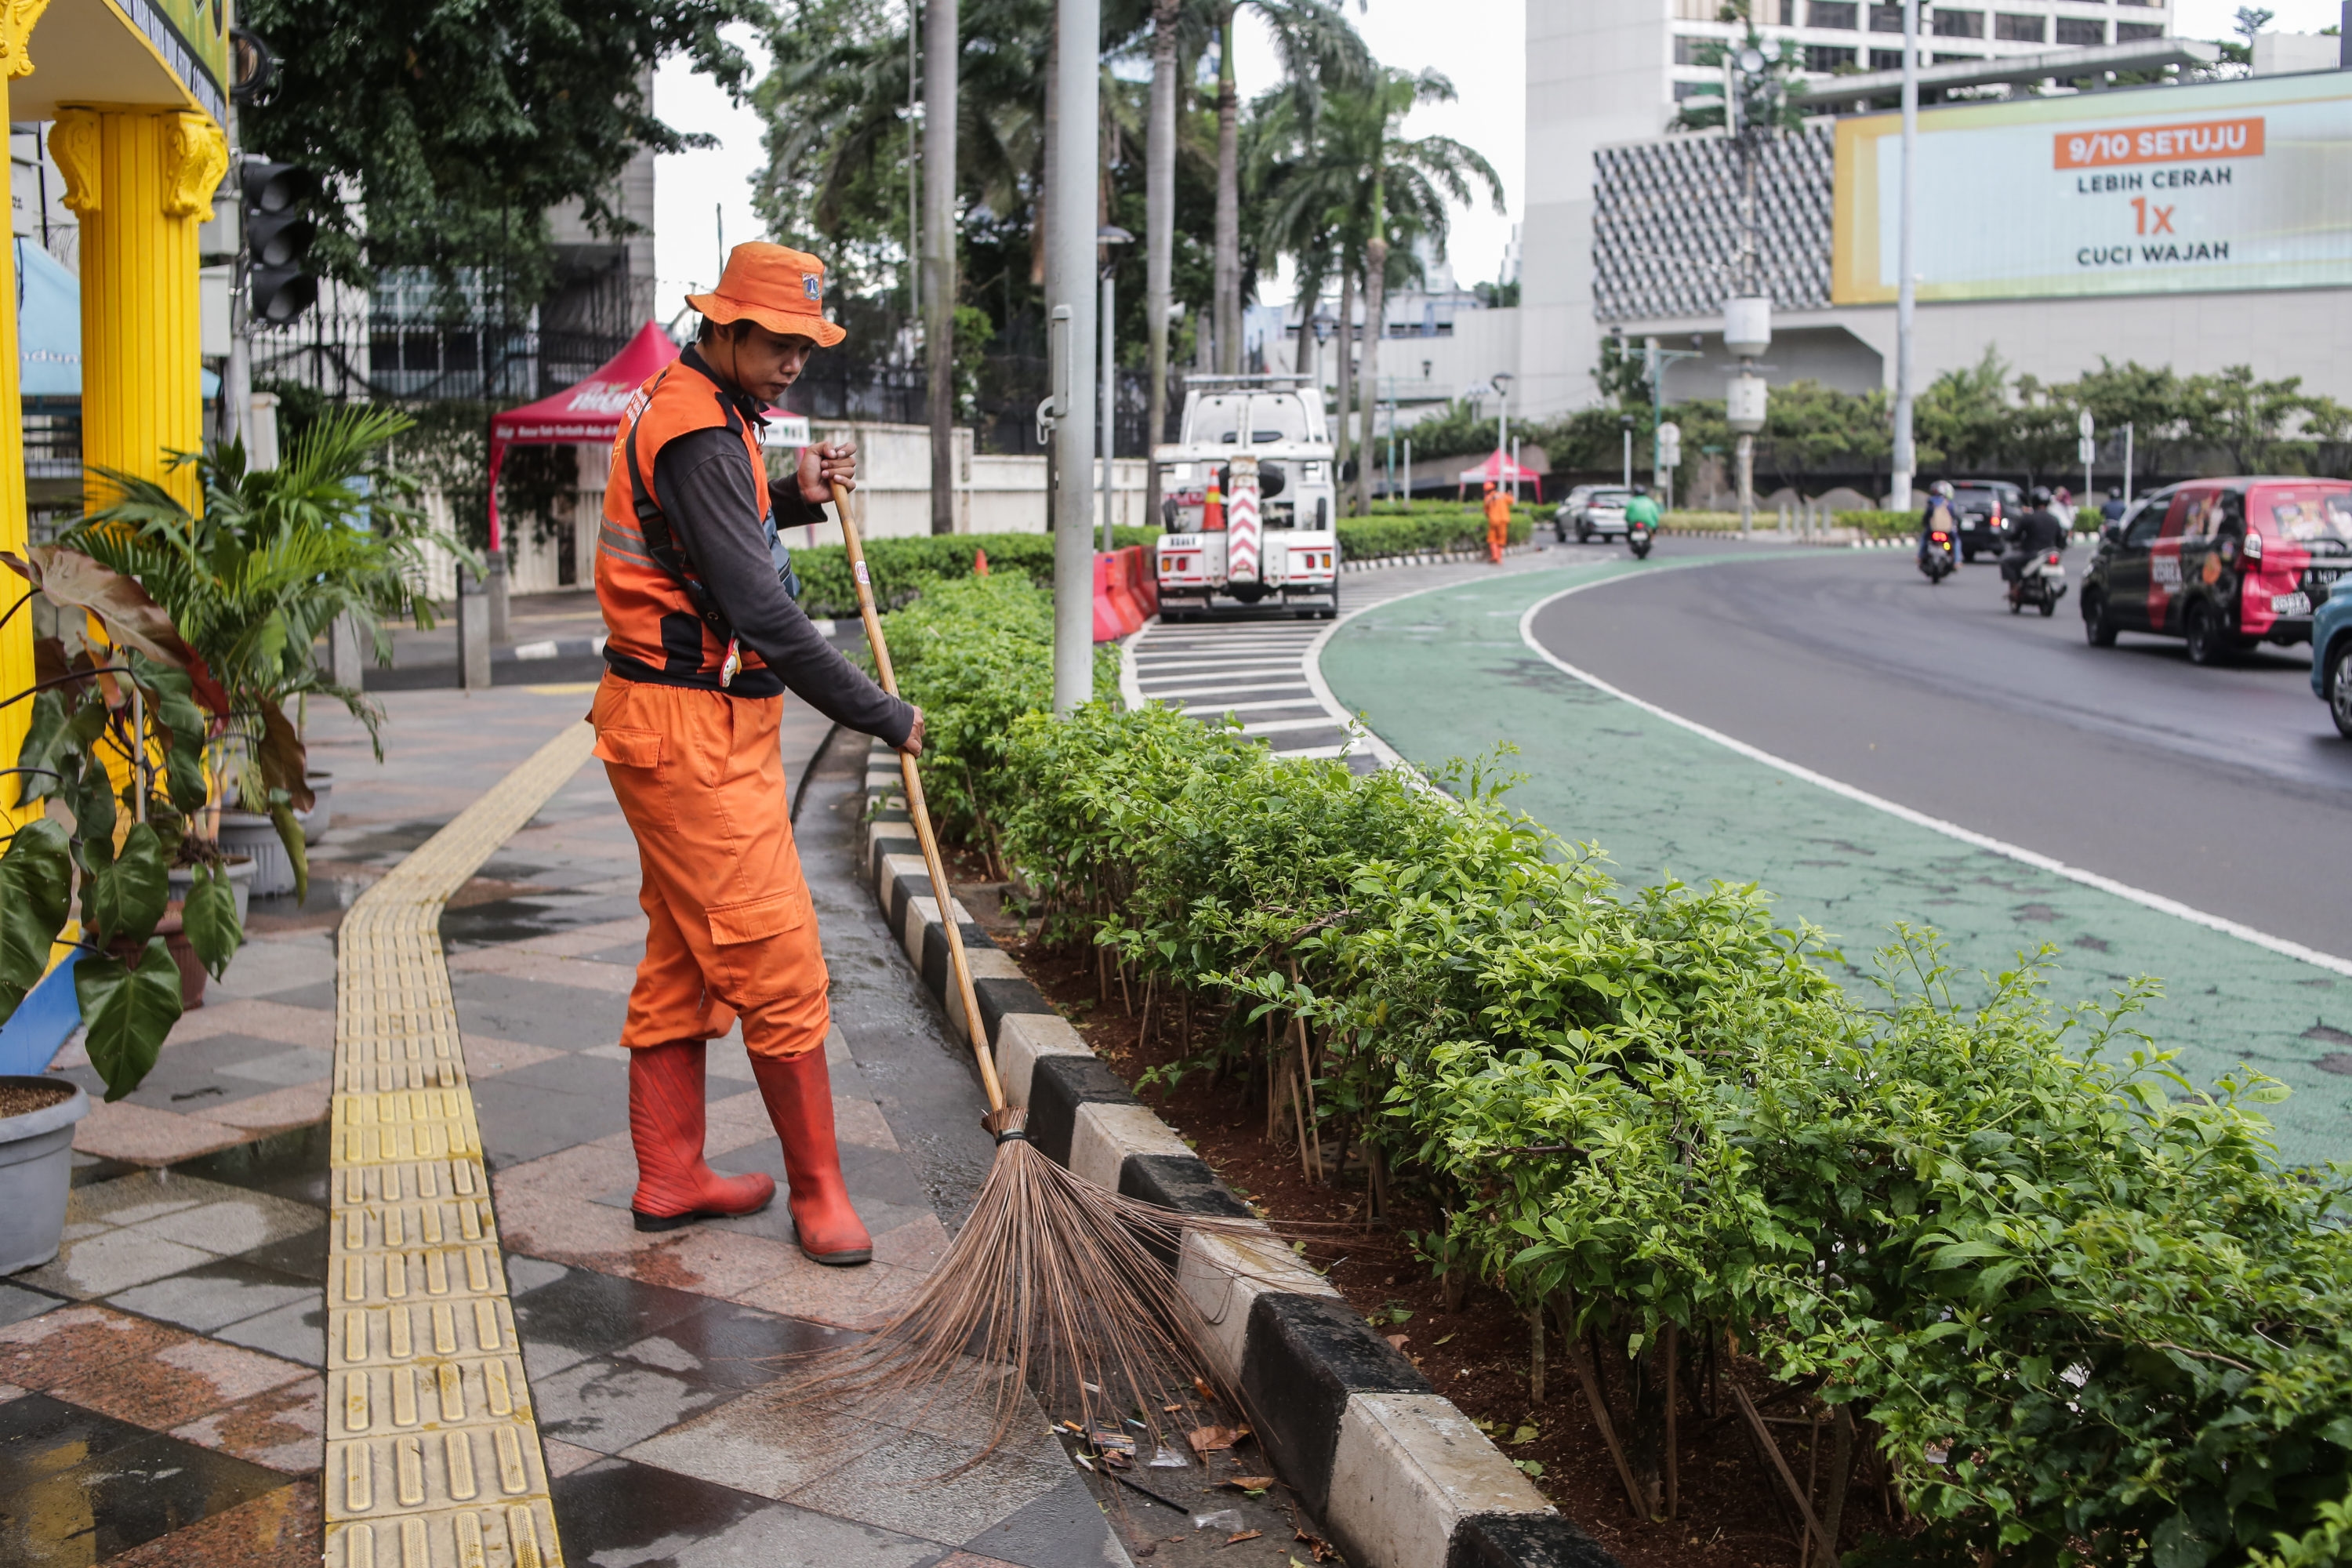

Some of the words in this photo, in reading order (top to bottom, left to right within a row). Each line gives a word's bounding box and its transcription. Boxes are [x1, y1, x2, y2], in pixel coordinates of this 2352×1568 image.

[2068, 132, 2130, 165] 9/10
[2137, 125, 2247, 157] SETUJU
[2078, 172, 2143, 194] LEBIH
[2151, 166, 2231, 189] CERAH
[2129, 196, 2175, 235] 1x
[2077, 247, 2132, 266] CUCI
[2142, 241, 2229, 263] WAJAH
